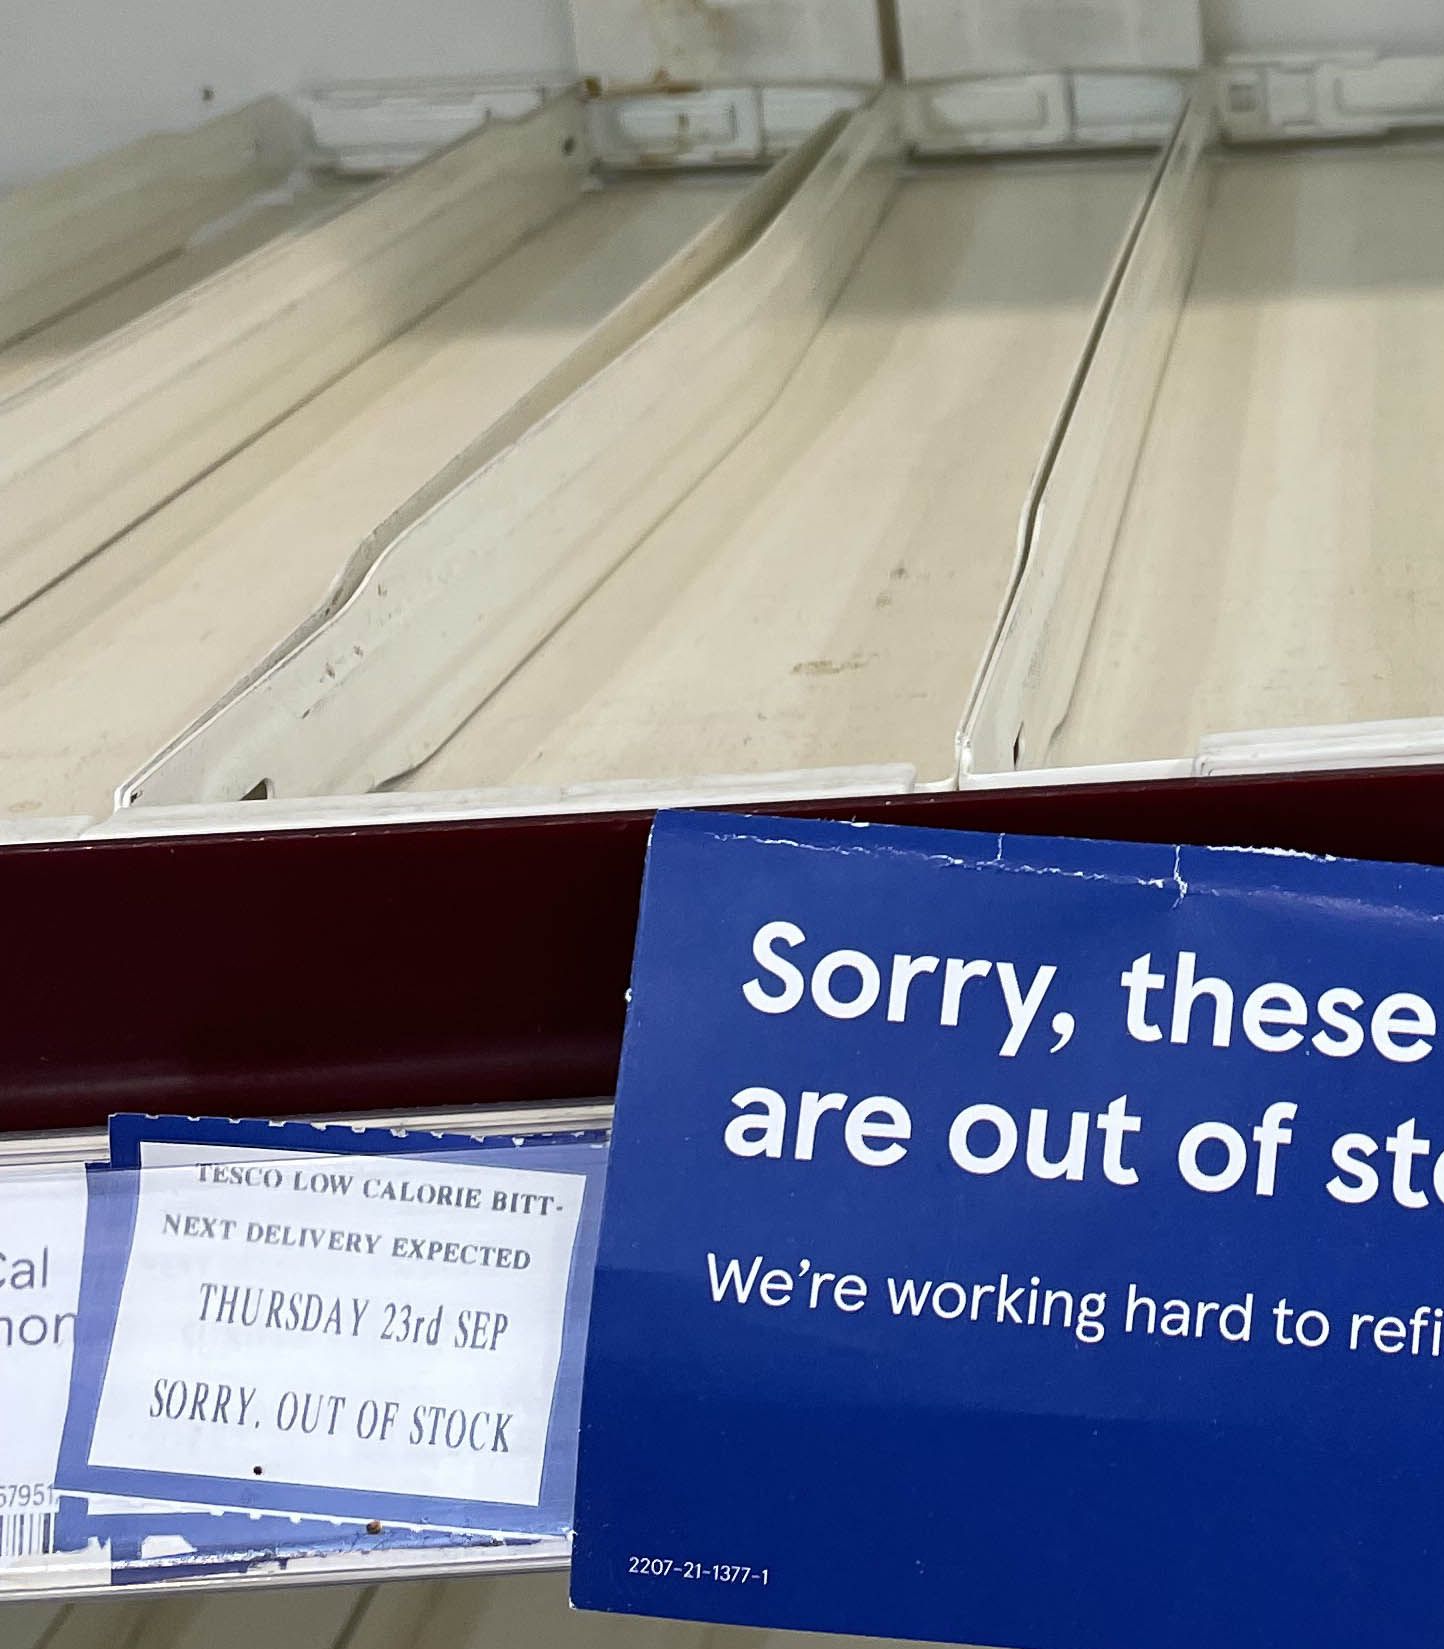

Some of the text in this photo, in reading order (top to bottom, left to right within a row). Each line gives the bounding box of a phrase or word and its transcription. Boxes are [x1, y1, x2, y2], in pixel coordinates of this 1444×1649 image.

[742, 921, 1076, 1057] Sorry,
[1121, 952, 1437, 1063] these
[724, 1086, 912, 1167] are
[949, 1094, 1142, 1186] out
[1177, 1101, 1298, 1197] of
[196, 1163, 283, 1188] TESCO
[293, 1171, 354, 1196] LOW
[363, 1177, 482, 1209] CALORIE
[0, 1245, 48, 1290] al
[162, 1213, 532, 1271] NEXT DELIVERY EXPECTED
[198, 1282, 510, 1352] THURSDAY 23rd SEP
[886, 1274, 1107, 1343] working
[1125, 1283, 1254, 1342] hard
[1272, 1299, 1330, 1347] to
[276, 1391, 346, 1436] OUT
[356, 1399, 401, 1442] OF
[409, 1404, 514, 1454] STOCK
[628, 1556, 770, 1586] 2207-21-1377-1
